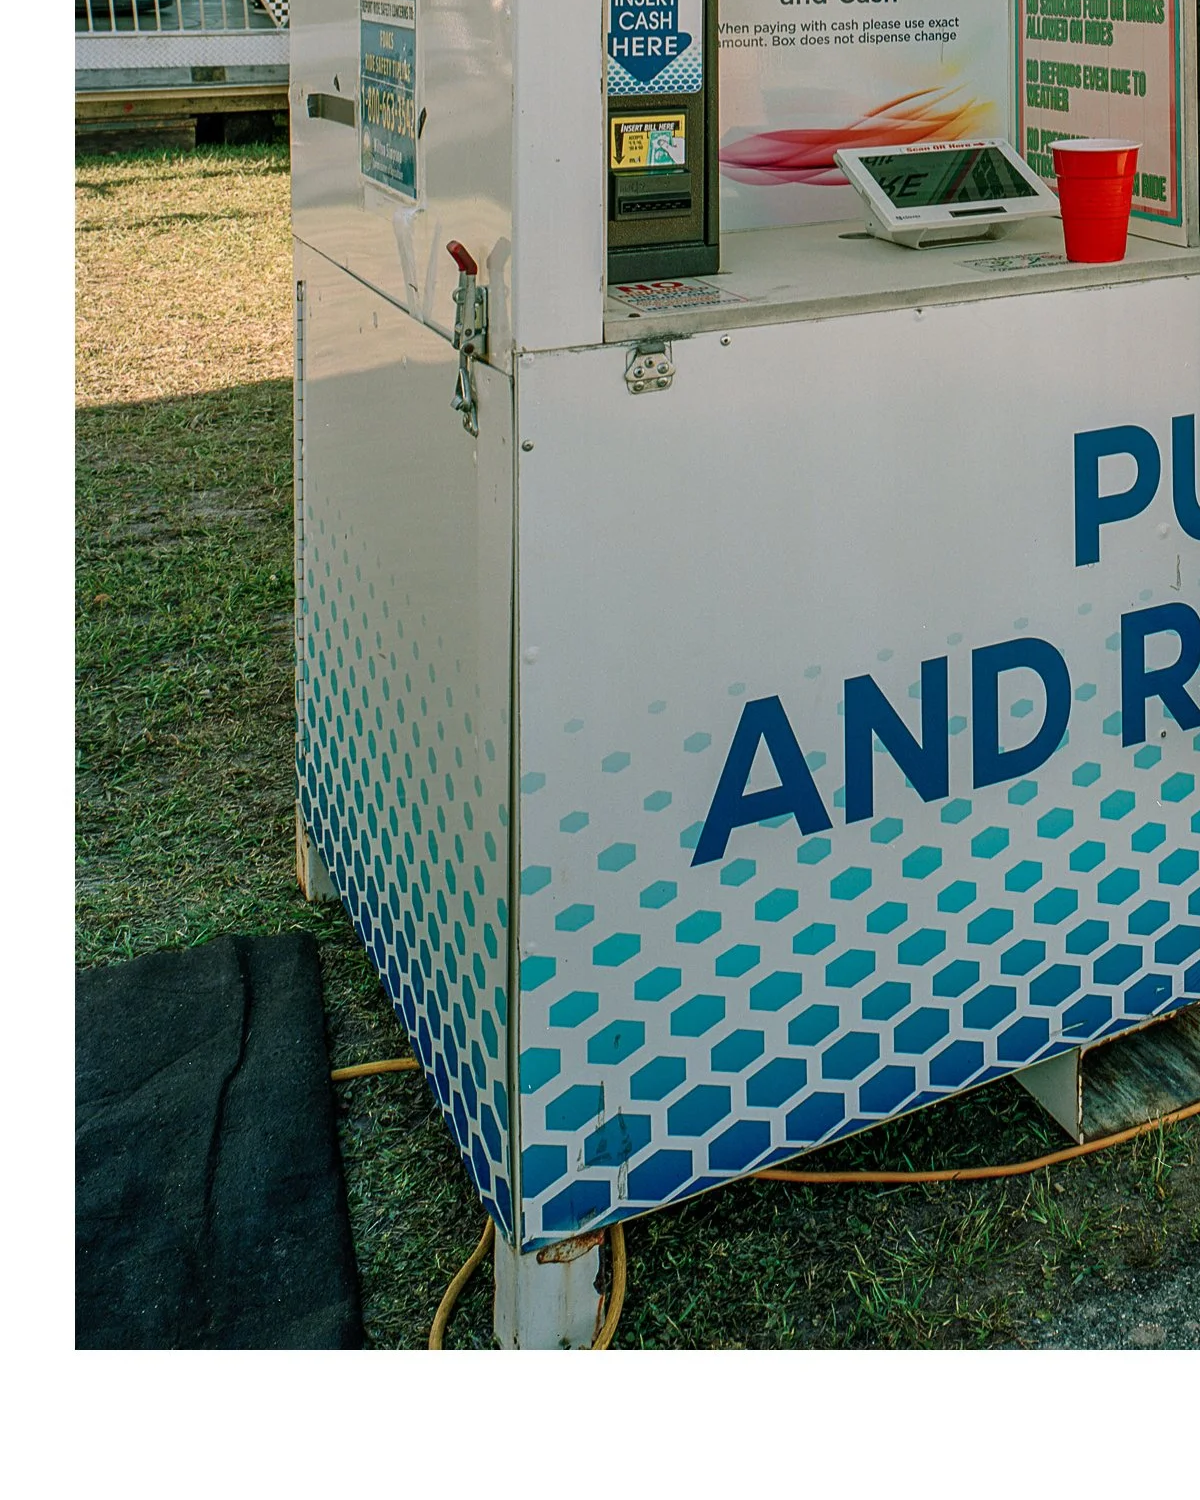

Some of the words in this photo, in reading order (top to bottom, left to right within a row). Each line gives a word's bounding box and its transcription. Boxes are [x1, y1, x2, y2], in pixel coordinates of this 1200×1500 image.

[618, 11, 672, 31] CASH
[754, 21, 796, 38] paying
[800, 19, 827, 32] with
[831, 18, 859, 31] cash
[862, 17, 901, 33] please
[904, 19, 925, 29] use
[928, 17, 960, 28] exact
[1026, 16, 1069, 43] ALLOWED
[1070, 19, 1083, 44] ON
[1085, 20, 1114, 47] RIDES
[612, 35, 678, 57] HERE
[771, 35, 796, 47] Box
[800, 33, 830, 46] does
[834, 34, 854, 45] not
[858, 31, 911, 45] dispense
[914, 29, 957, 43] change
[1026, 58, 1039, 82] NO
[1040, 60, 1081, 89] REFUNDS
[1083, 64, 1109, 92] EVEN
[1111, 67, 1131, 95] DUE
[1132, 69, 1147, 98] TO
[1026, 82, 1070, 113] WEATHER
[620, 123, 644, 133] INSERT
[643, 123, 657, 131] BILL
[1026, 126, 1040, 152] NO
[1141, 173, 1167, 202] RIDE
[615, 281, 684, 293] NO
[690, 637, 1073, 868] AND
